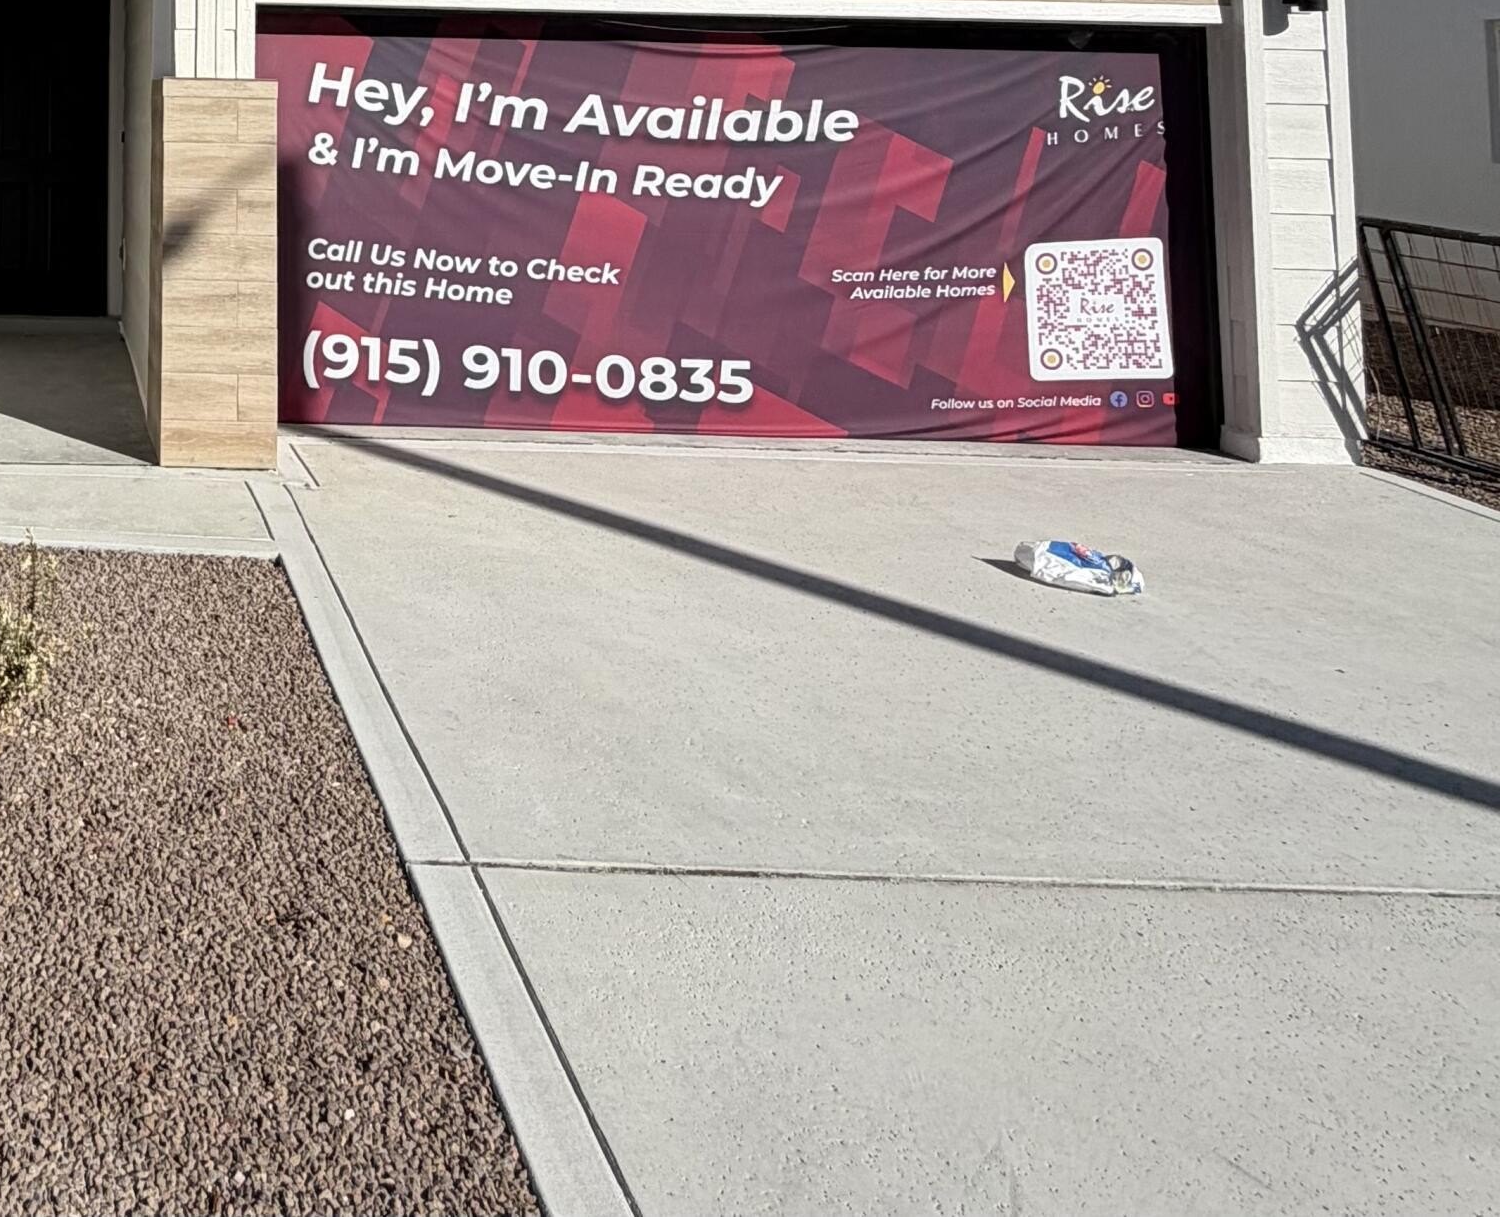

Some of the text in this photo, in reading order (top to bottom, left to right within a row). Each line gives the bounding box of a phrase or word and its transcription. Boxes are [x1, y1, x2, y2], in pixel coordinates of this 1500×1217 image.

[308, 62, 860, 143] Hey, I'm Available
[1059, 75, 1155, 122] Rise
[1047, 121, 1165, 145] HOMES
[308, 132, 784, 207] & I'm Move-In Ready
[307, 238, 621, 285] Call Us Now to Check
[831, 266, 997, 283] Scan Here for More
[306, 270, 514, 305] out this Home
[850, 284, 996, 300] Available Homes
[303, 329, 754, 404] (915) 910-0835
[931, 395, 1102, 410] Follow us on Social Media
